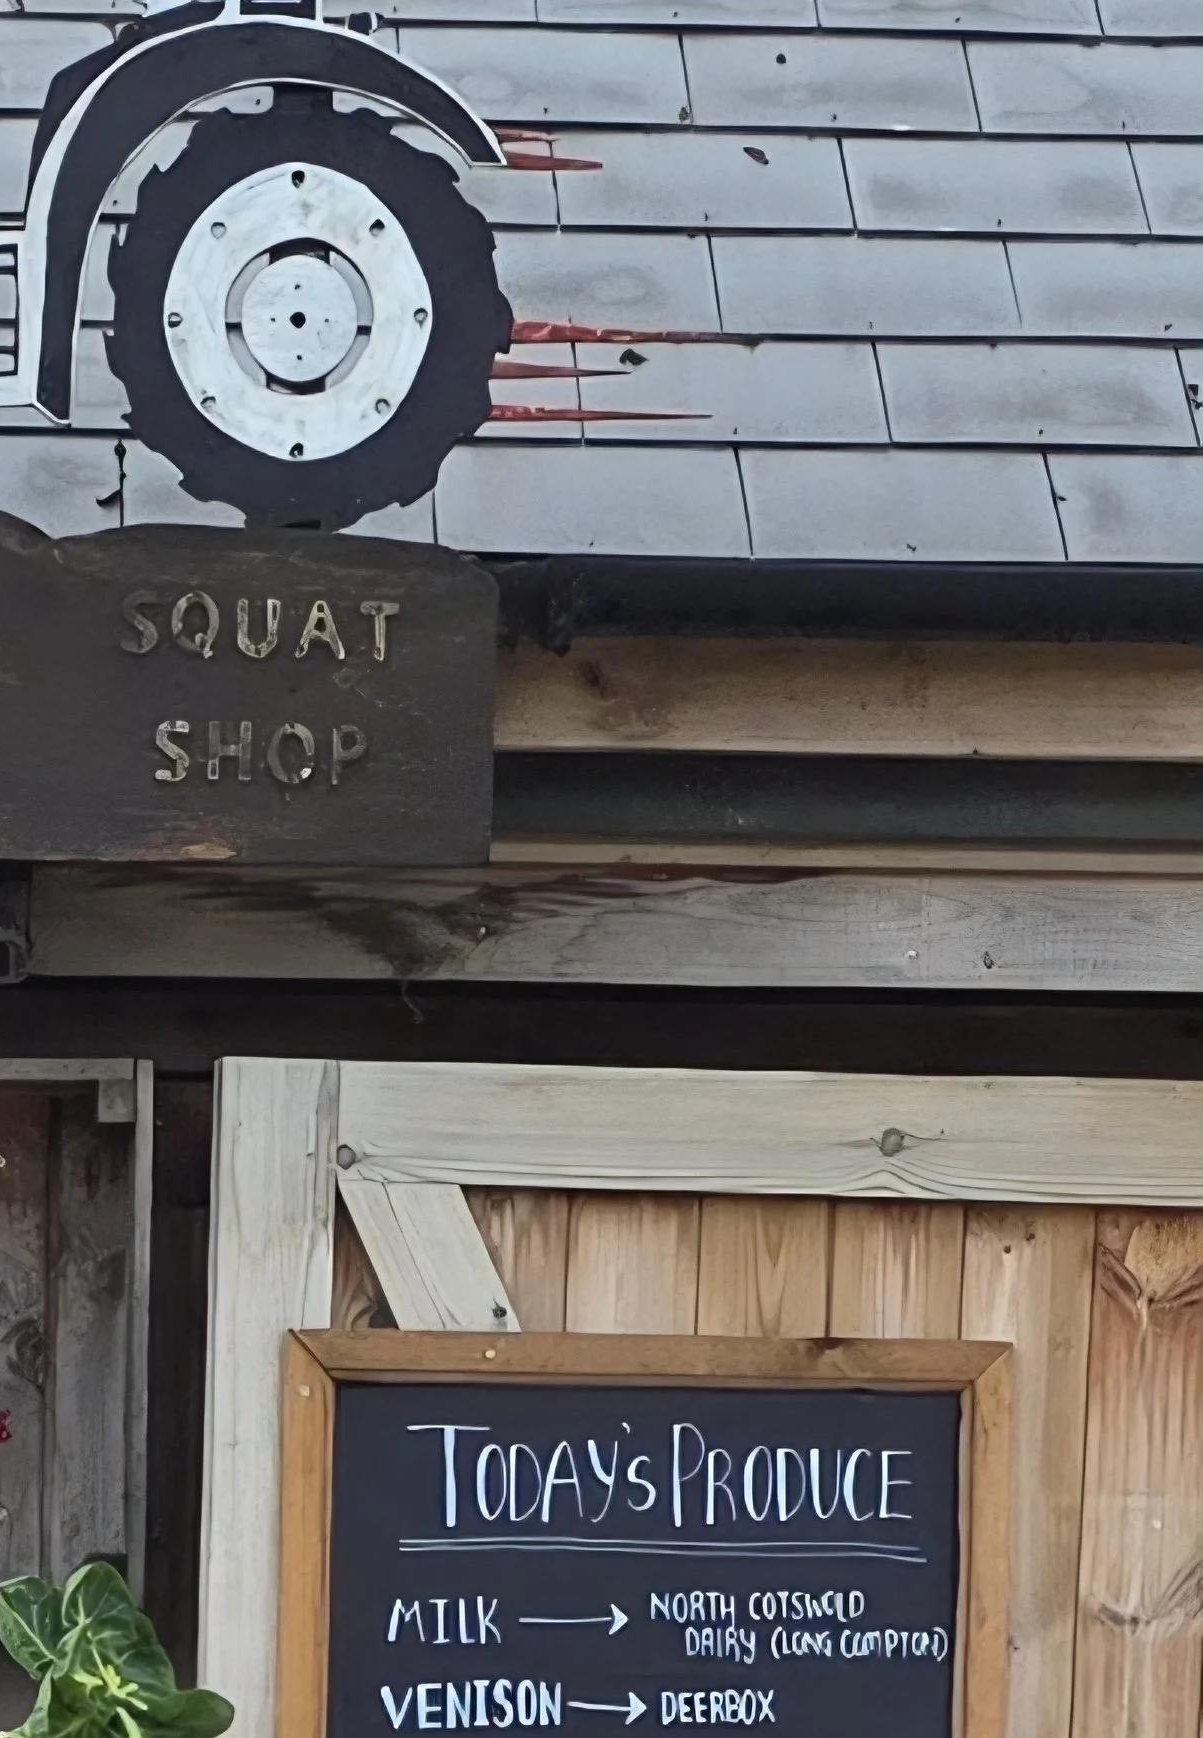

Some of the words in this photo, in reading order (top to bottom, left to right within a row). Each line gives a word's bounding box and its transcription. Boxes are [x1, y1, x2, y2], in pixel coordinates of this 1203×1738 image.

[120, 590, 399, 661] SQUAT
[153, 719, 368, 785] SHOP
[672, 1422, 912, 1528] PRODUCE
[387, 1596, 502, 1644] MILK
[650, 1591, 735, 1629] NORTH
[685, 1626, 756, 1664] DAIRY
[380, 1678, 562, 1730] VENISON
[661, 1689, 776, 1725] DEERBOX
